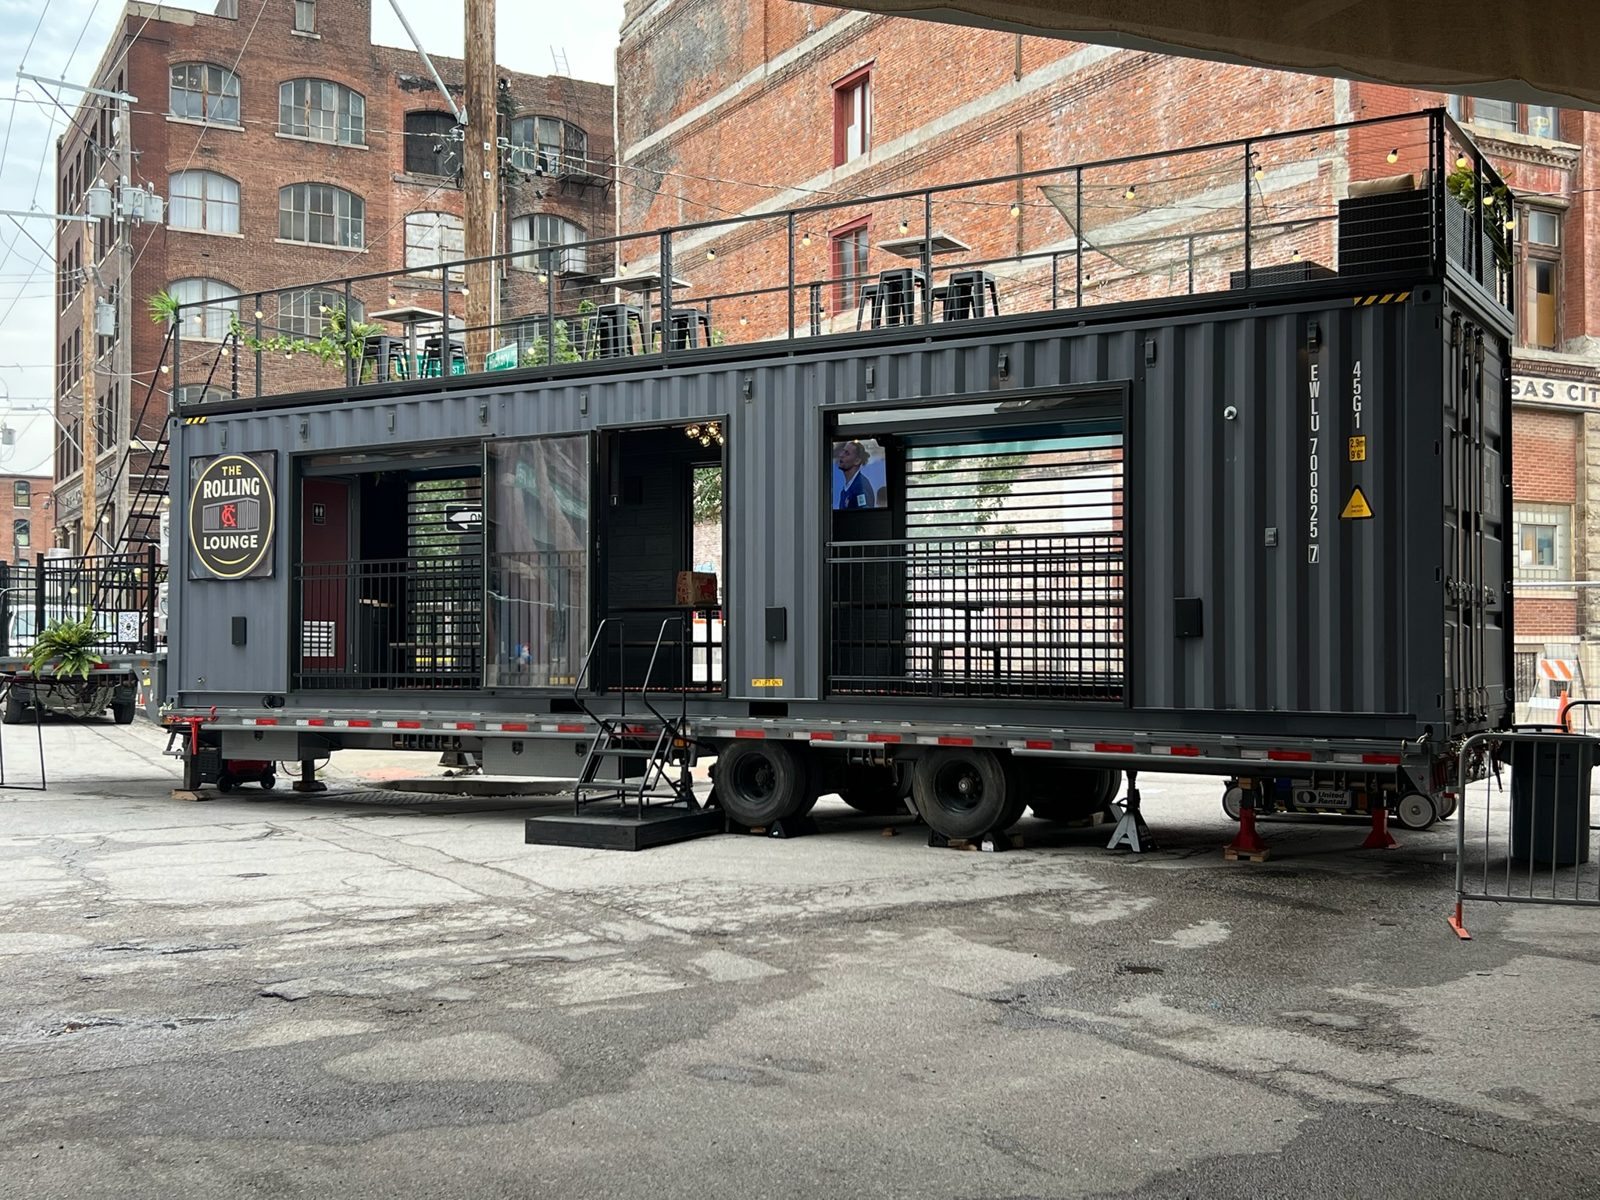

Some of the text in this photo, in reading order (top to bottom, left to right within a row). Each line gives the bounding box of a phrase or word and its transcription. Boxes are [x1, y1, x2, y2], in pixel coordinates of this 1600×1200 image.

[1352, 360, 1361, 429] 45G1
[222, 465, 242, 476] THE
[1308, 364, 1320, 562] EWLU 700625 7
[203, 477, 260, 499] ROLLING
[203, 535, 258, 550] LOUNGE
